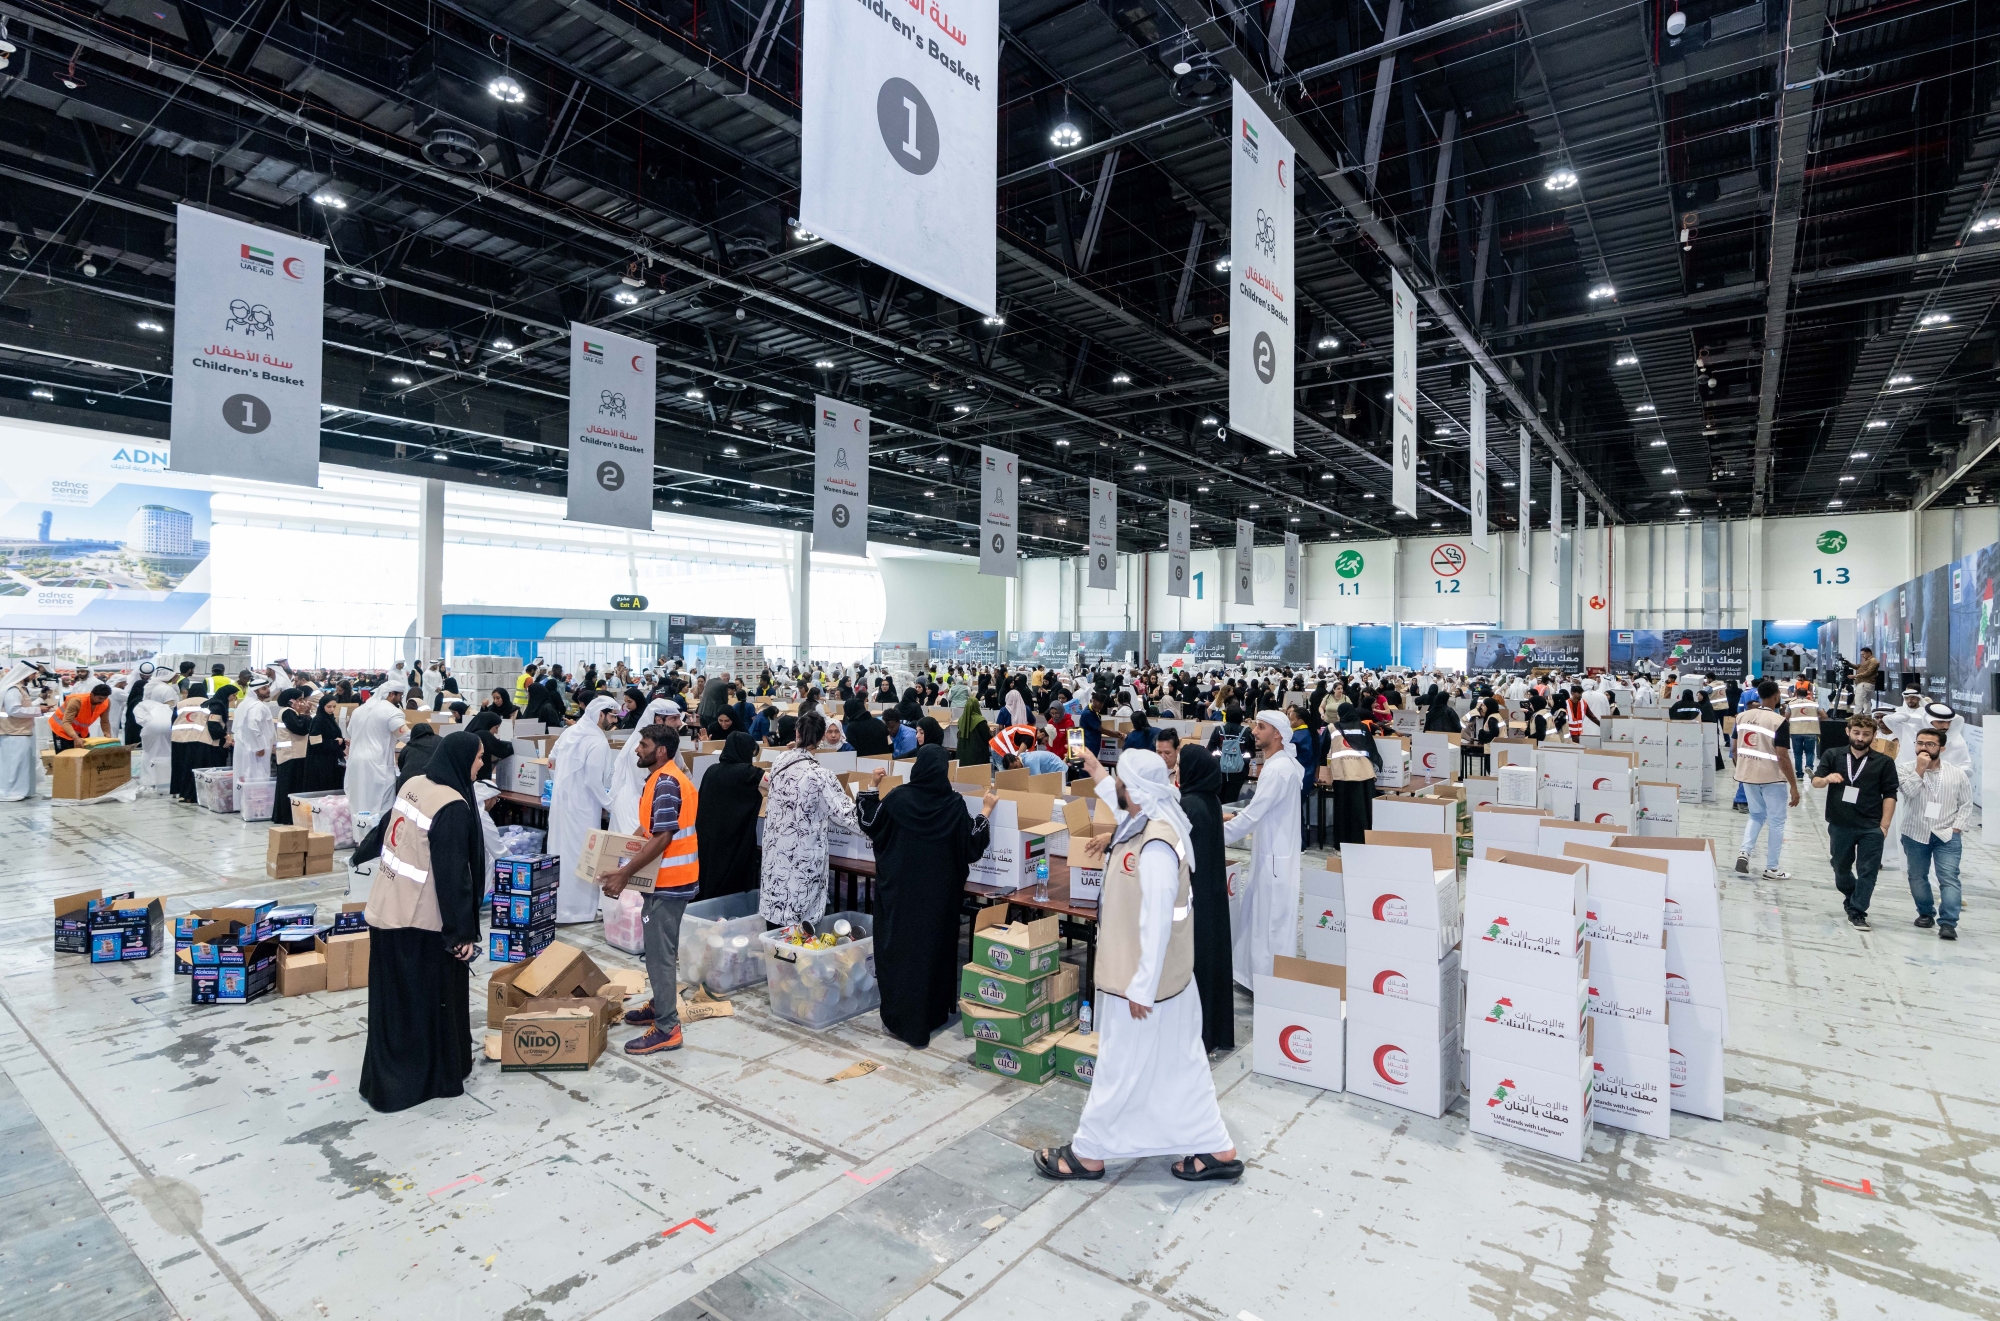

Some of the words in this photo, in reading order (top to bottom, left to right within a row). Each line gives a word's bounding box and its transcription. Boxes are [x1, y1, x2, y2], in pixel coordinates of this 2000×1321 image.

[930, 1, 967, 46] سلة
[857, 0, 924, 50] ldren's
[928, 38, 981, 91] Basket
[902, 96, 921, 160] 1
[240, 262, 258, 272] UAE
[259, 268, 274, 277] AID
[1240, 283, 1270, 312] Children's
[1270, 302, 1289, 326] Basket
[204, 344, 260, 363] الأطفال
[583, 355, 594, 363] UAE
[1258, 340, 1271, 376] 2
[263, 355, 293, 369] سلة
[192, 358, 259, 378] Children's
[262, 371, 305, 387] Basket
[242, 401, 257, 427] 1
[586, 424, 618, 437] الأطفال
[620, 430, 638, 441] سلة
[580, 435, 618, 450] Children's
[619, 443, 644, 454] Basket
[1402, 442, 1409, 463] 3
[602, 466, 618, 486] 2
[827, 477, 844, 486] النساء
[52, 486, 89, 495] centre
[823, 485, 842, 494] Women
[842, 488, 859, 497] Basket
[835, 510, 846, 523] 3
[994, 538, 1002, 549] 4
[1100, 558, 1105, 567] 5
[1177, 568, 1181, 577] 6
[1813, 567, 1851, 585] 1.3
[1192, 571, 1204, 600] 1
[1338, 582, 1360, 596] 1.1
[1435, 579, 1461, 594] 1.2
[38, 597, 74, 605] centre
[632, 597, 641, 608] A
[1527, 653, 1548, 663] لبنان
[1694, 647, 1742, 656] #الإمارات
[1548, 655, 1555, 664] يا
[1557, 655, 1579, 663] معك
[1681, 655, 1705, 665] لبنان
[1706, 656, 1714, 666] يا
[1717, 656, 1742, 664] معك
[991, 853, 997, 862] يا
[997, 854, 1012, 863] معك
[1024, 865, 1036, 874] UAE
[1081, 877, 1101, 887] UAE
[1511, 930, 1561, 946] #الإمارات
[1599, 925, 1650, 940] #الإمارات
[981, 987, 989, 995] al
[989, 988, 1004, 999] ain
[688, 1006, 713, 1016] NIDO
[1601, 1000, 1652, 1016] #الإمارات
[1515, 1012, 1565, 1029] #الإمارات
[976, 1029, 983, 1037] al
[984, 1030, 999, 1039] ain
[518, 1035, 557, 1048] NIDO
[1077, 1065, 1085, 1074] al
[1593, 1081, 1618, 1094] لبنان
[1607, 1076, 1657, 1091] #الإمارات
[1620, 1087, 1628, 1098] يا
[1631, 1091, 1658, 1103] معك
[1504, 1100, 1529, 1115] لبنان
[1518, 1094, 1569, 1112] #الإمارات
[1594, 1099, 1614, 1108] stands
[1614, 1102, 1626, 1110] with
[1626, 1104, 1653, 1116] Lebanon"
[1531, 1107, 1539, 1116] يا
[1542, 1110, 1569, 1124] معك
[1491, 1112, 1506, 1122] "UAE
[1506, 1117, 1524, 1127] stands
[1524, 1121, 1537, 1130] with
[1537, 1125, 1565, 1137] Lebanon"
